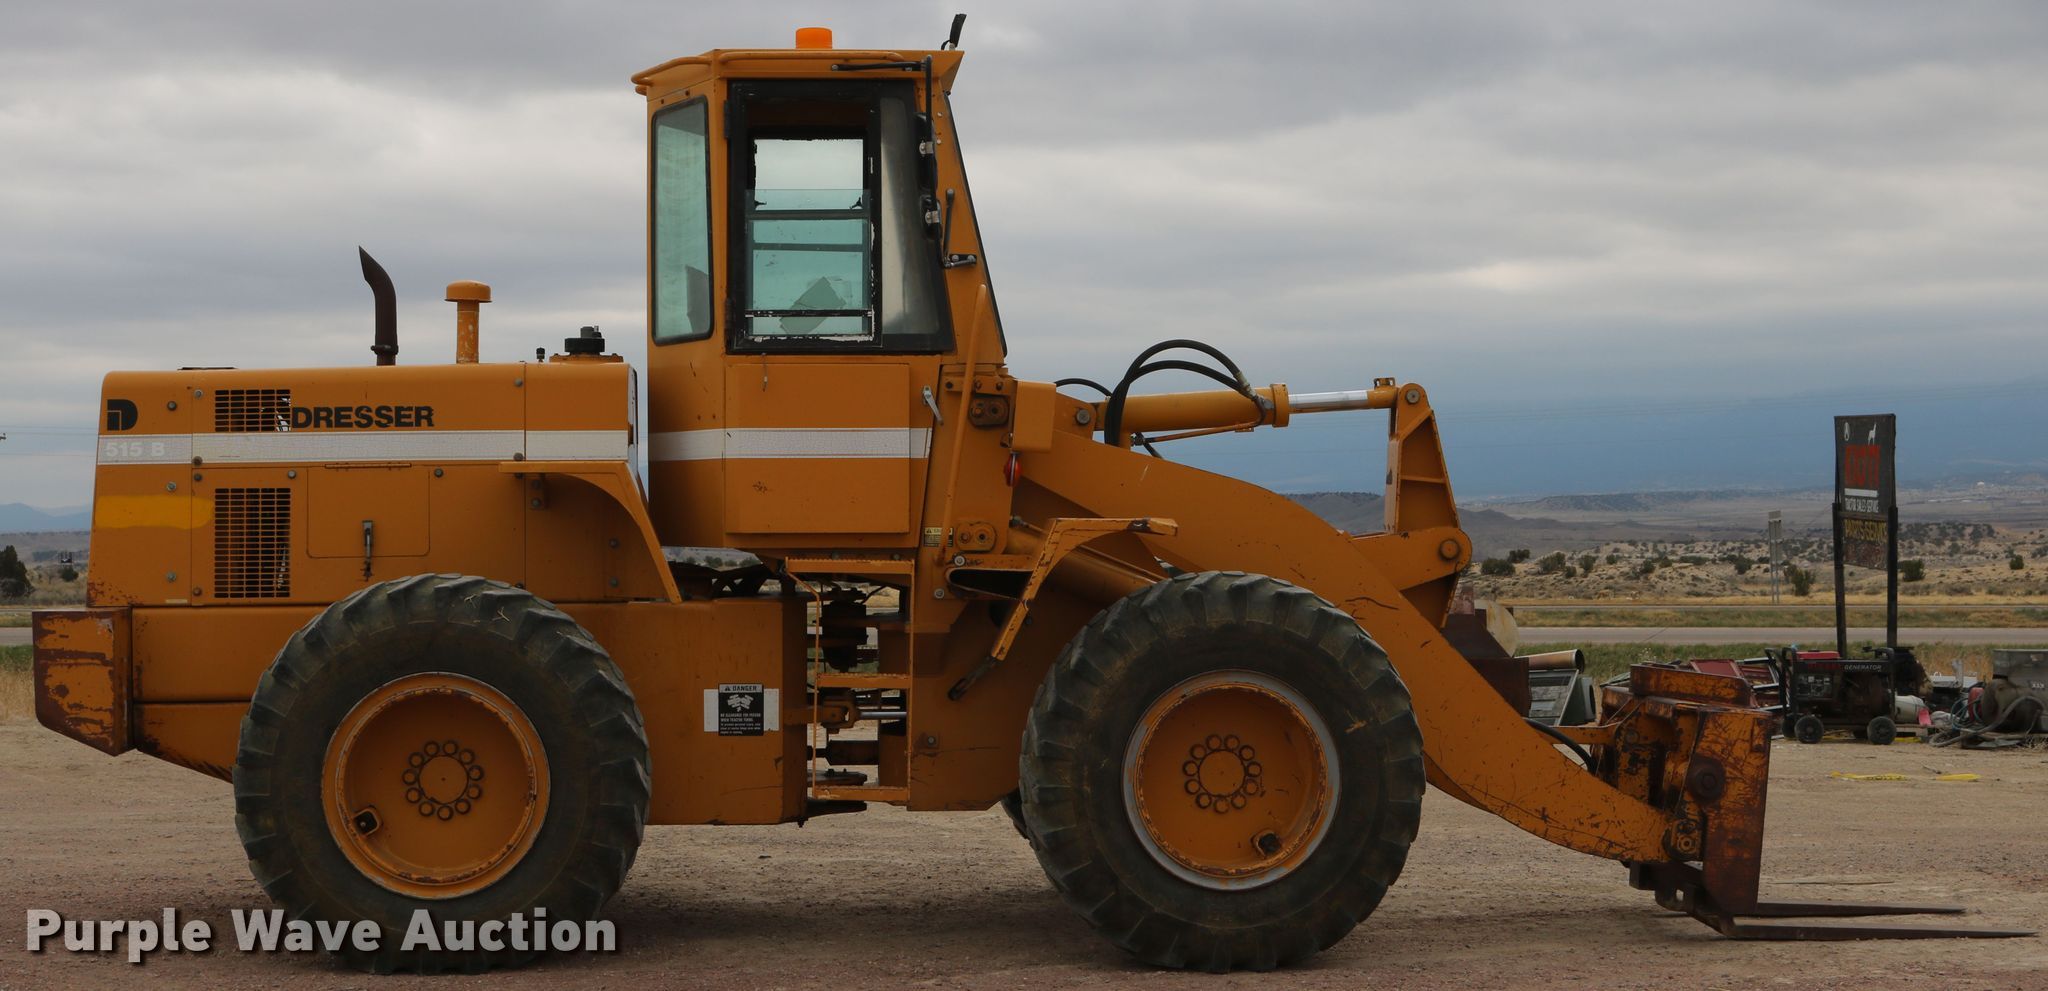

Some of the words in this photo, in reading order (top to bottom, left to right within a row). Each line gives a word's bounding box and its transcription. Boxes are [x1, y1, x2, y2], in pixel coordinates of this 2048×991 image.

[292, 405, 434, 428] DRESSER
[105, 442, 143, 458] 515
[151, 442, 165, 457] B
